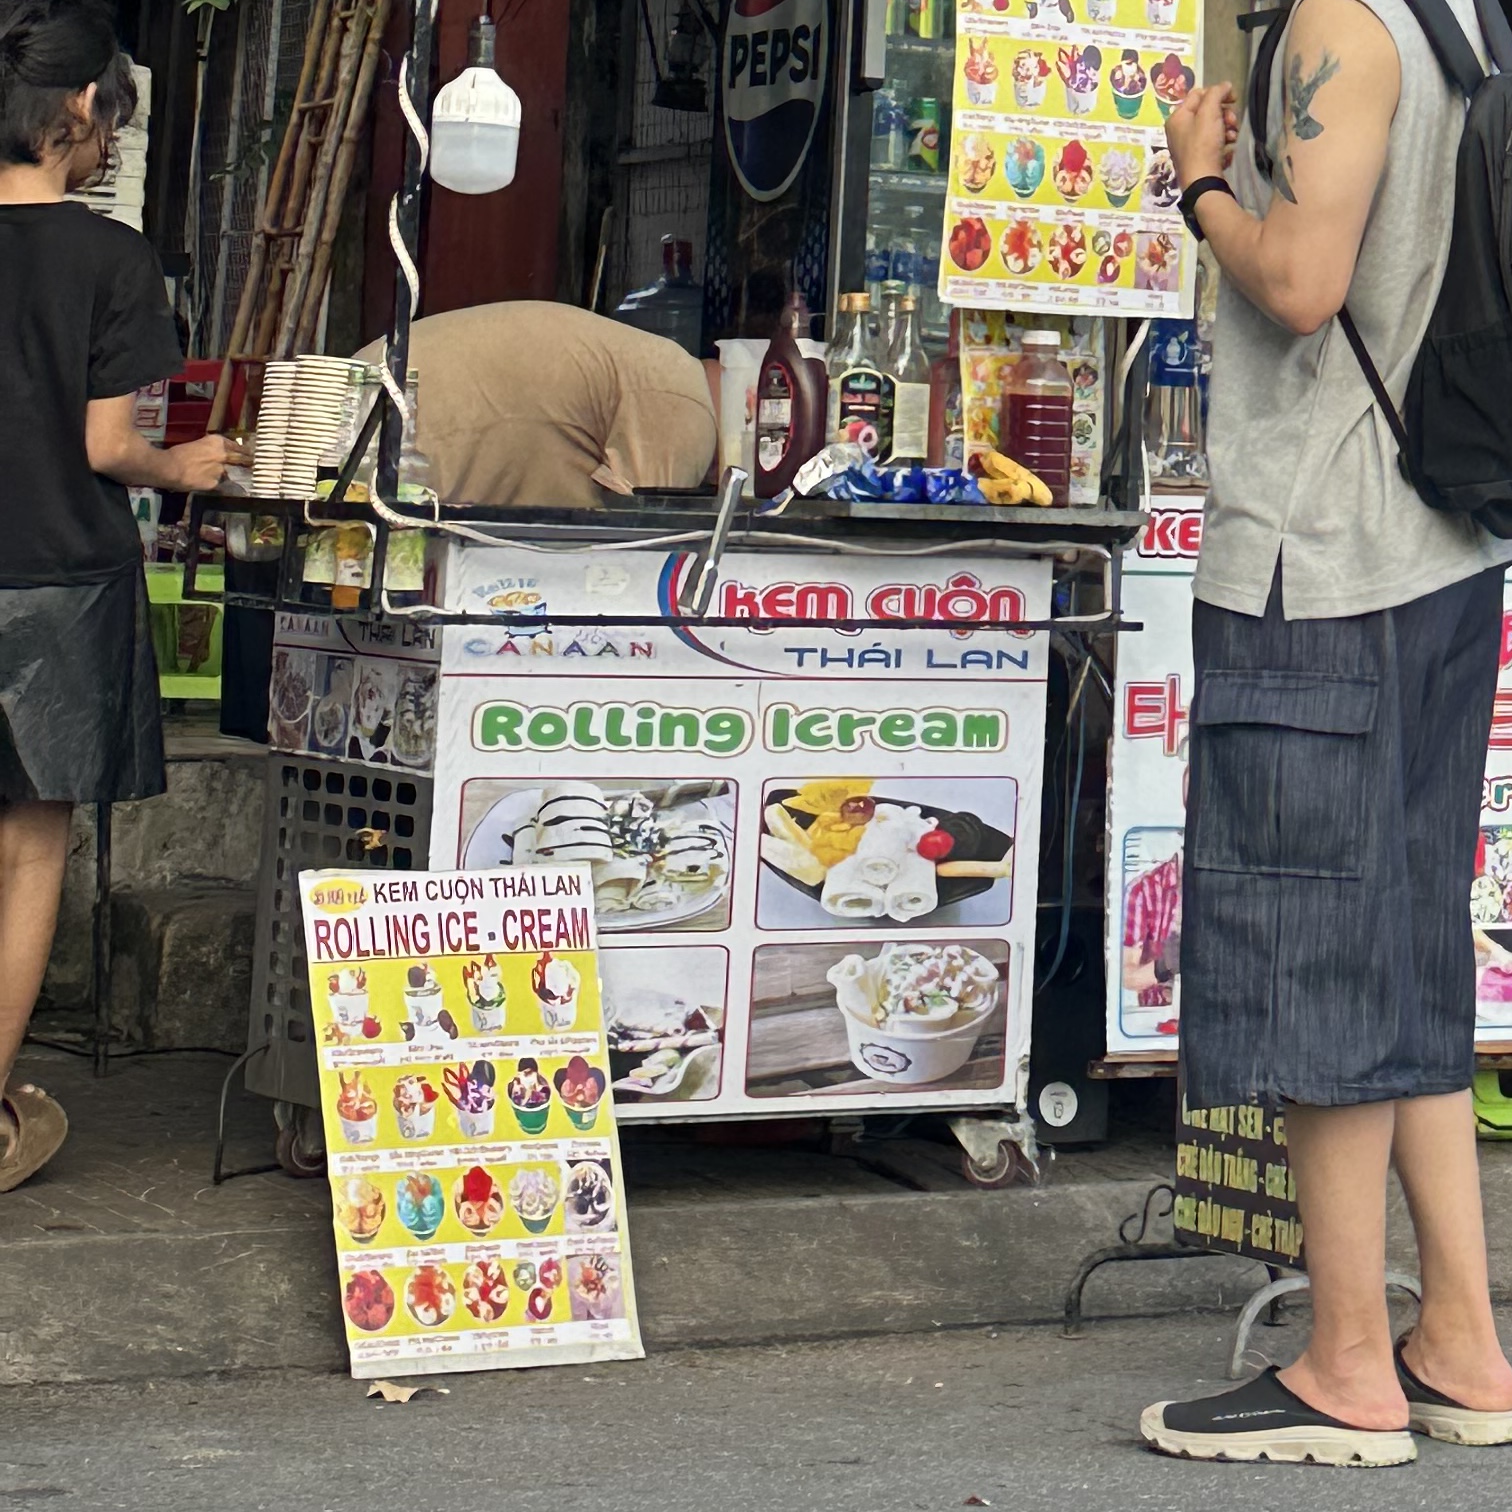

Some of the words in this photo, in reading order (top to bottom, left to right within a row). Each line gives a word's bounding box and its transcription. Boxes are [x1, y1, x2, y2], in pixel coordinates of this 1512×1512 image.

[729, 22, 822, 89] PEPSI
[1144, 515, 1203, 552] KE
[464, 638, 654, 658] CANAAN
[784, 642, 902, 669] THÁI
[926, 648, 1028, 670] LAN
[481, 706, 746, 753] Rolling
[772, 707, 1000, 748] Icream
[1126, 675, 1189, 756] 타
[373, 881, 419, 904] KEM
[425, 877, 484, 906] CUỘN
[489, 872, 535, 899] THÁI
[541, 874, 582, 897] LAN
[314, 913, 430, 960] ROLLING
[438, 911, 480, 955] ICE
[502, 907, 591, 952] CREAM
